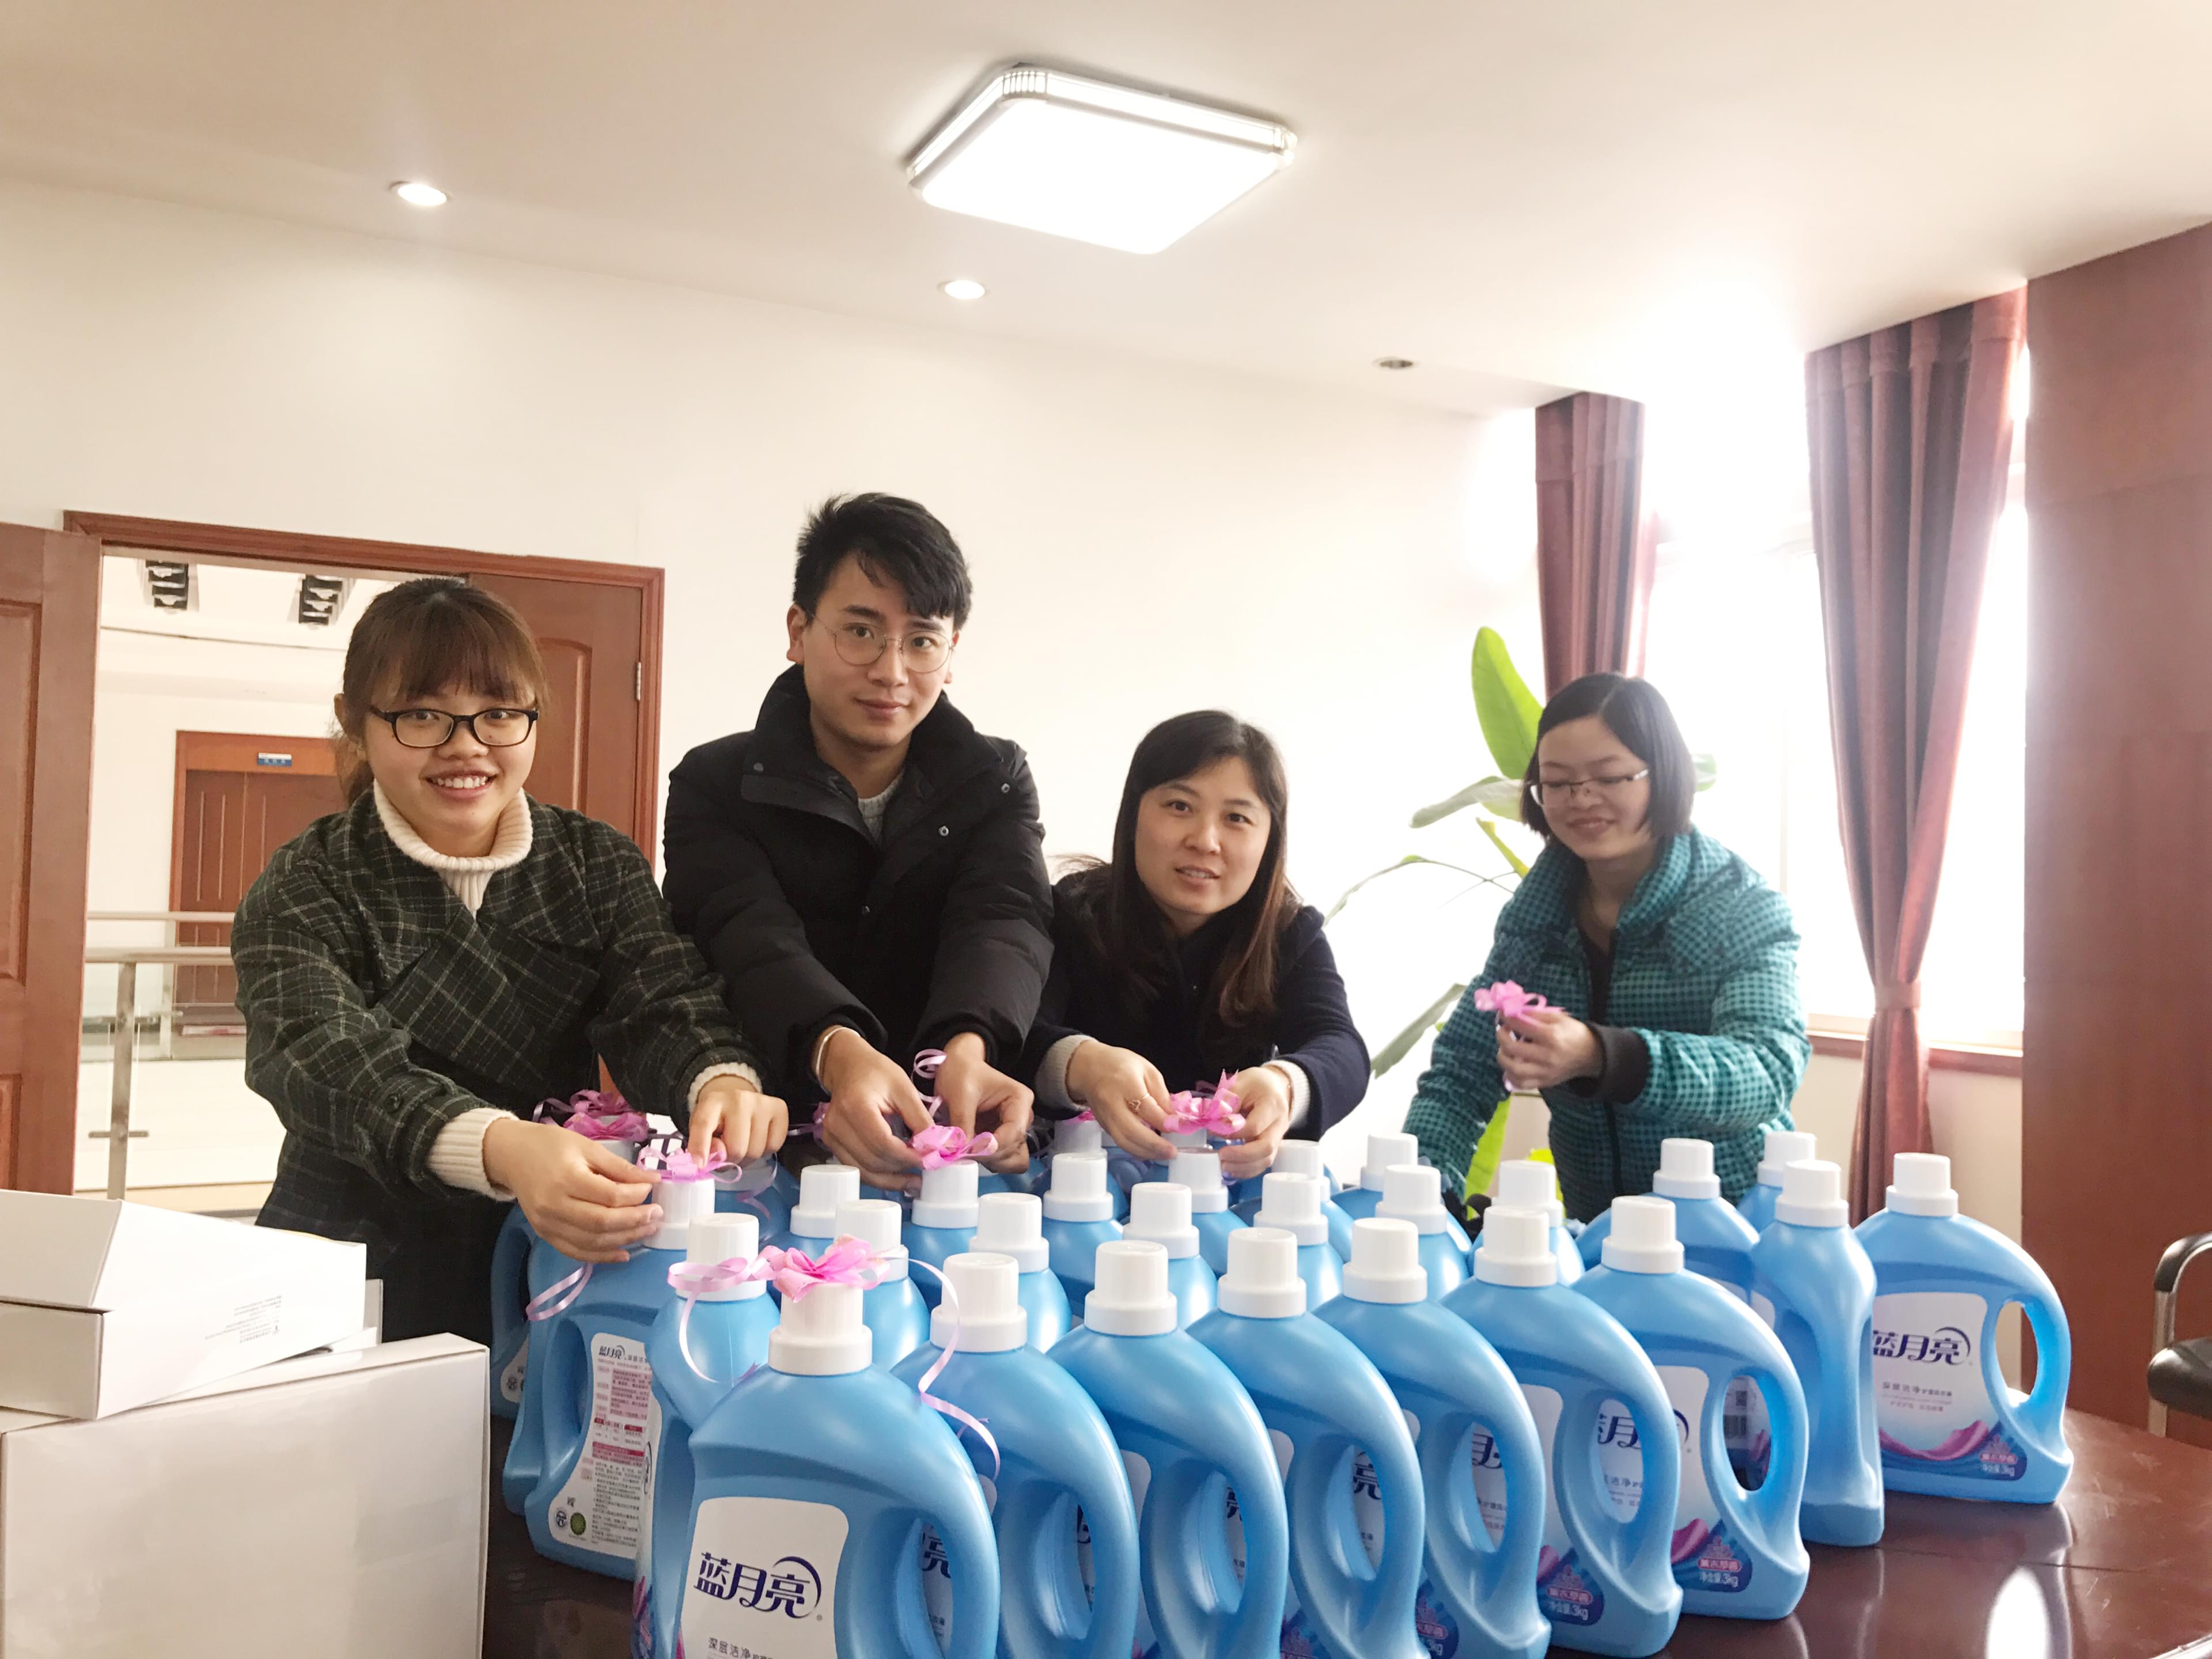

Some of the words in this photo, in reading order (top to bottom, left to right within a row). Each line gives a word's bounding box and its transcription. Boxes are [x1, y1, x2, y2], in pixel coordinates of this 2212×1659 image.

[1873, 1327, 1970, 1365] 蓝月亮
[694, 1552, 821, 1619] 蓝月亮
[709, 1637, 773, 1659] 深层洁净
